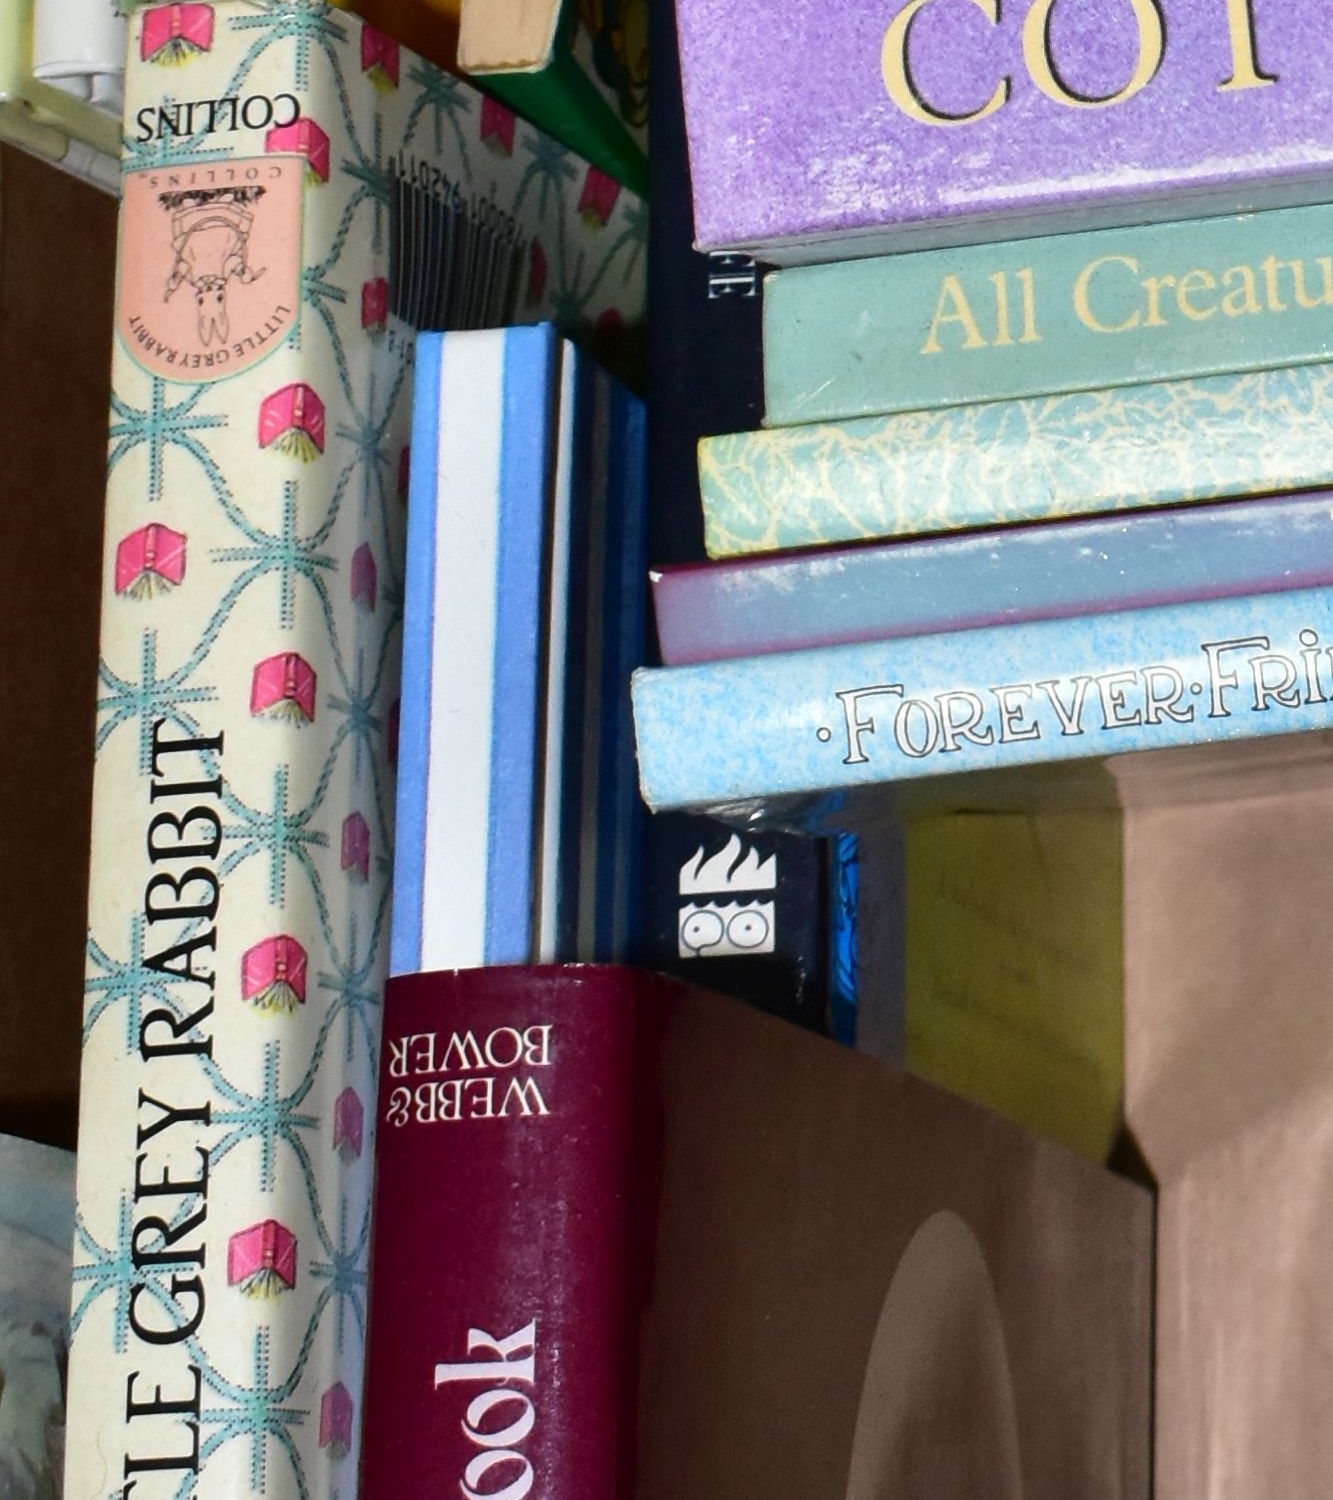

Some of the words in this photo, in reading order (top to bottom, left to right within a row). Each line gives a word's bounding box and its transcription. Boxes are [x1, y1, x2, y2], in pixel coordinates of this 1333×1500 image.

[136, 94, 300, 142] COLLINS
[920, 269, 1040, 355] All
[141, 719, 226, 1055] RABBIT
[388, 1023, 551, 1071] BOWER
[126, 1087, 214, 1346] GREY
